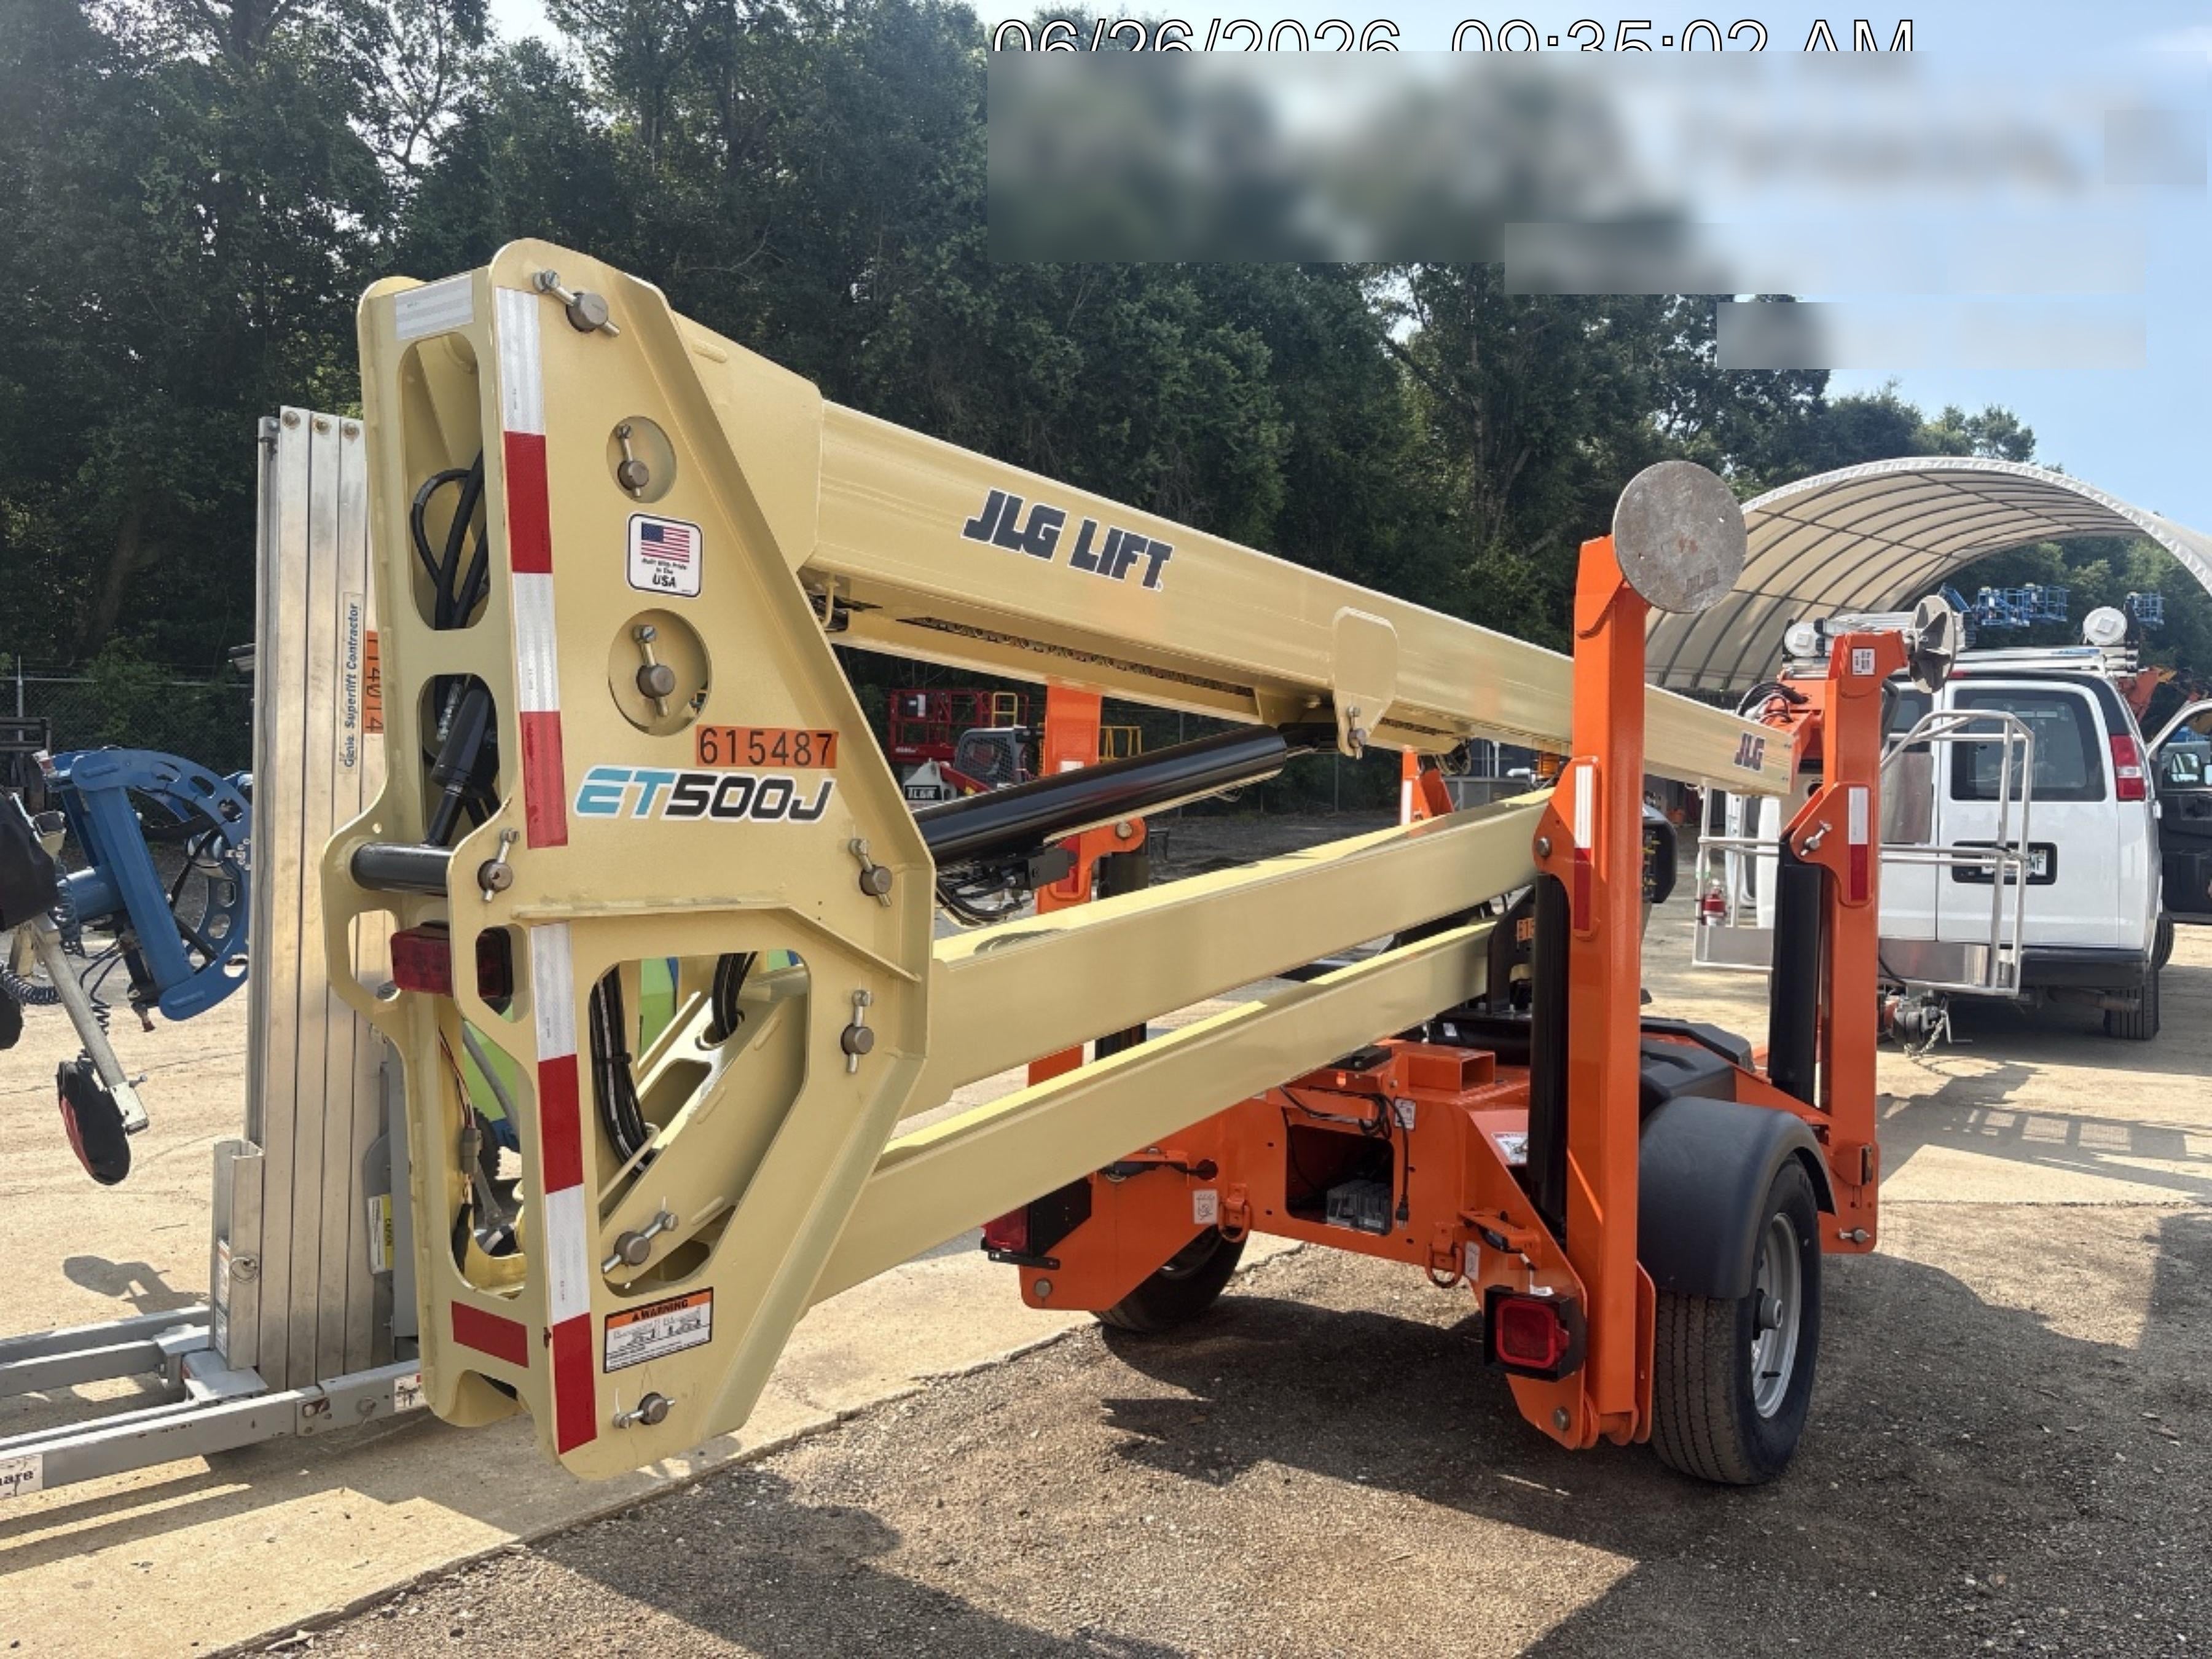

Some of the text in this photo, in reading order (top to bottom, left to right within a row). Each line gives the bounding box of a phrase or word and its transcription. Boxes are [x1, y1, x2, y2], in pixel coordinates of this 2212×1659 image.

[960, 487, 1174, 592] JLG LIFT
[652, 573, 677, 588] USA
[346, 603, 359, 670] Contractor
[344, 673, 358, 729] Superlift
[699, 728, 833, 766] 615487
[1733, 731, 1765, 772] JLG
[574, 764, 837, 824] ET500J
[641, 1298, 688, 1320] WARNING
